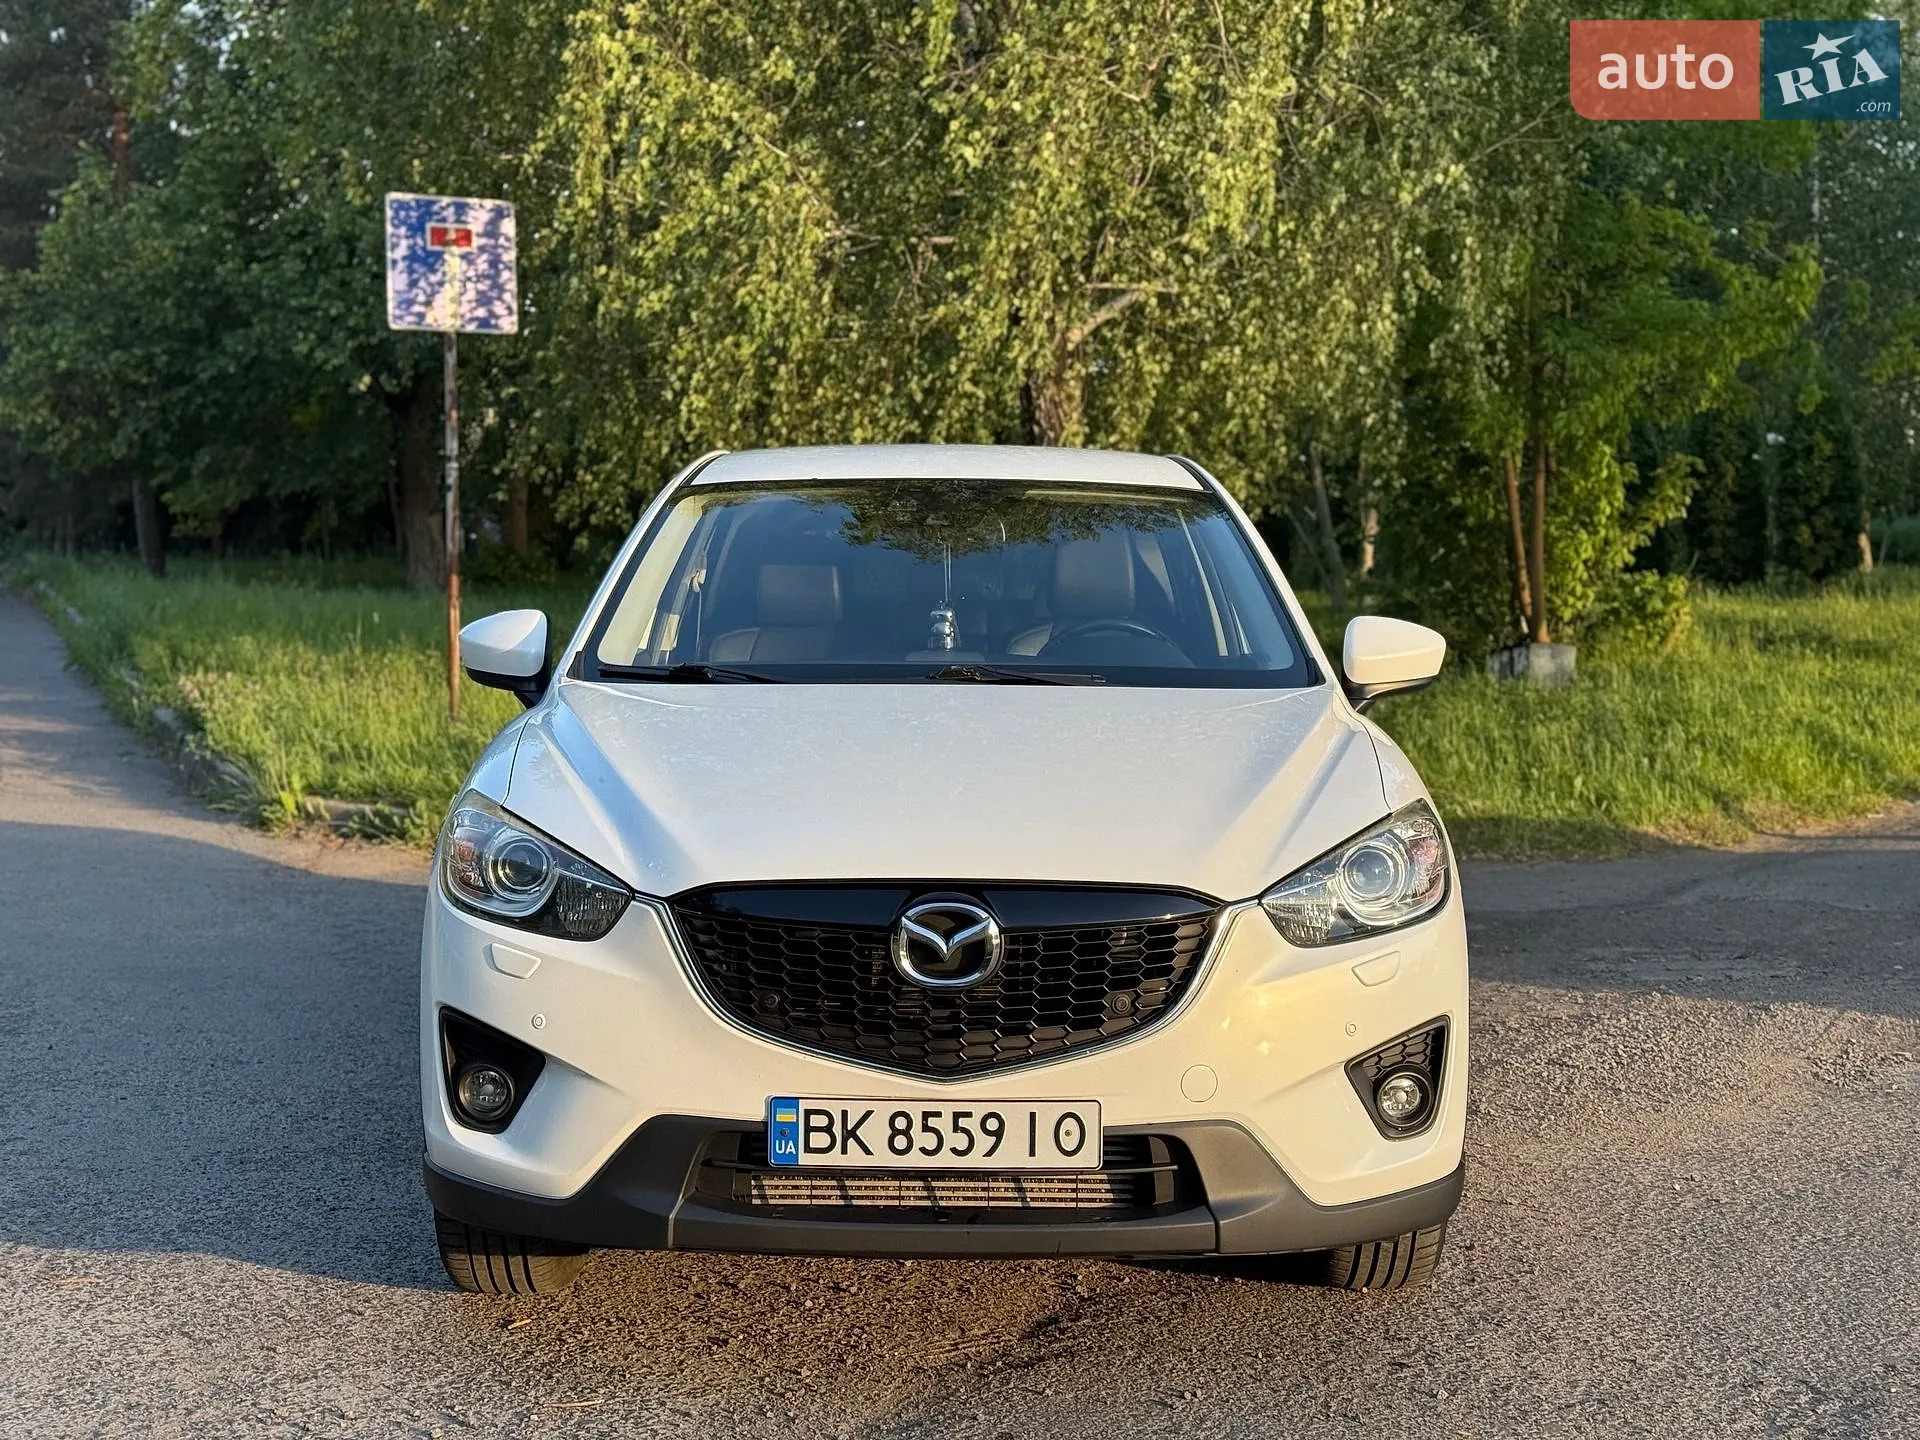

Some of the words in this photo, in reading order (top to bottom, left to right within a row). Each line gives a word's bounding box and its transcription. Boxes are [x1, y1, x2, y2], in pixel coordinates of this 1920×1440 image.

[775, 1140, 797, 1155] UA
[803, 1108, 876, 1157] BK
[887, 1110, 1006, 1158] 8559
[1028, 1111, 1087, 1158] IO
